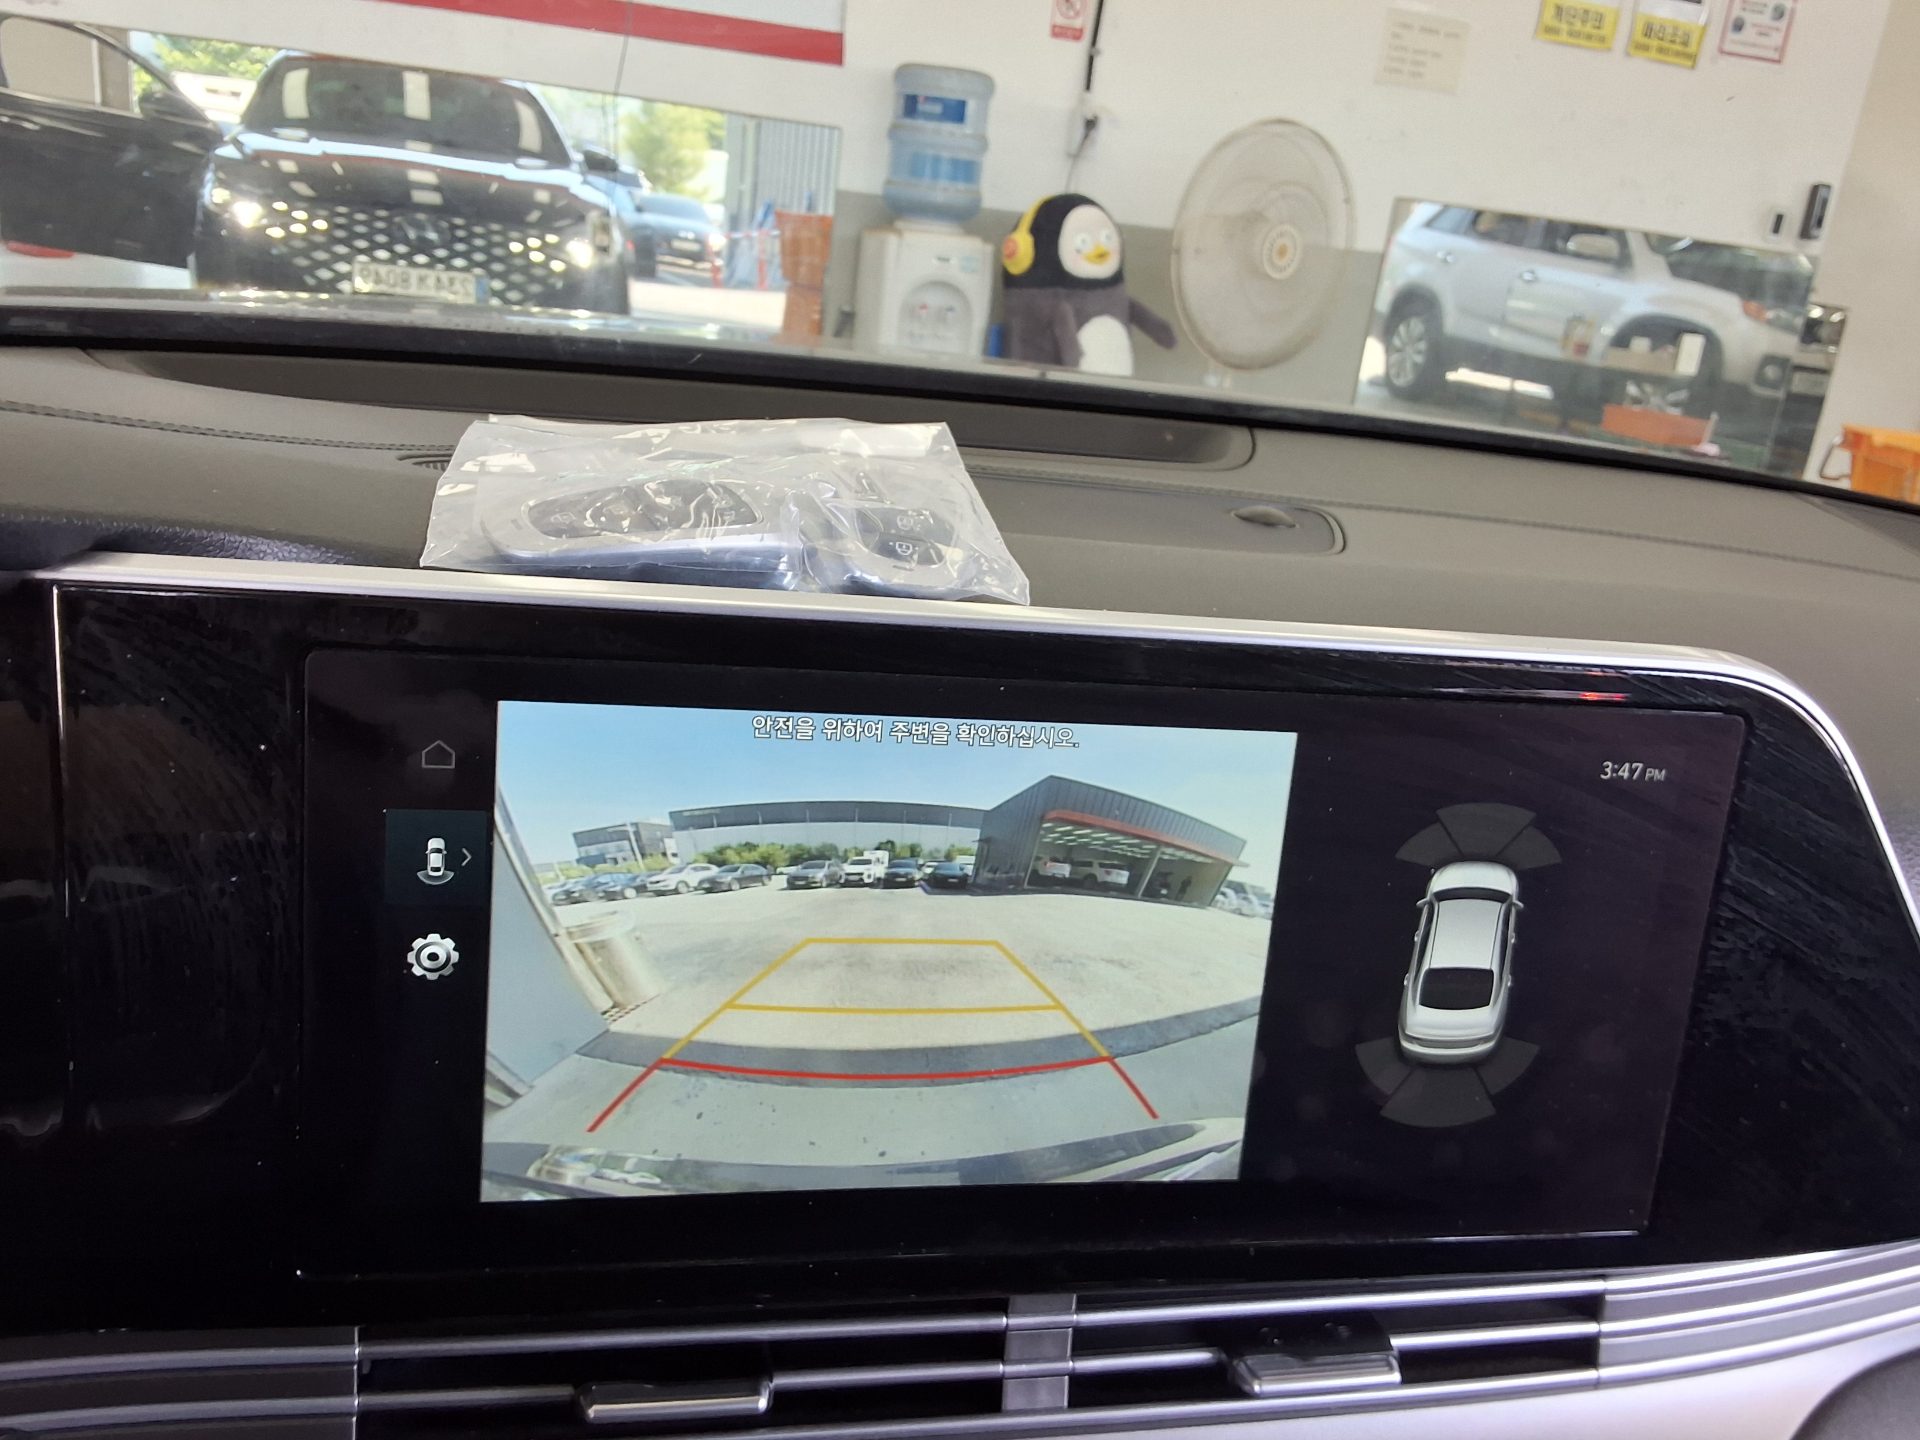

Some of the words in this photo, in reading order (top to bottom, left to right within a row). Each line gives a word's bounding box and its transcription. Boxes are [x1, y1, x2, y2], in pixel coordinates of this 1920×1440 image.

[751, 715, 816, 740] 안전을
[821, 718, 884, 743] 위하여
[889, 721, 951, 746] 주변을
[956, 723, 1080, 749] 확인하십시오.
[1600, 761, 1644, 780] 3:47
[1645, 768, 1666, 782] PM
